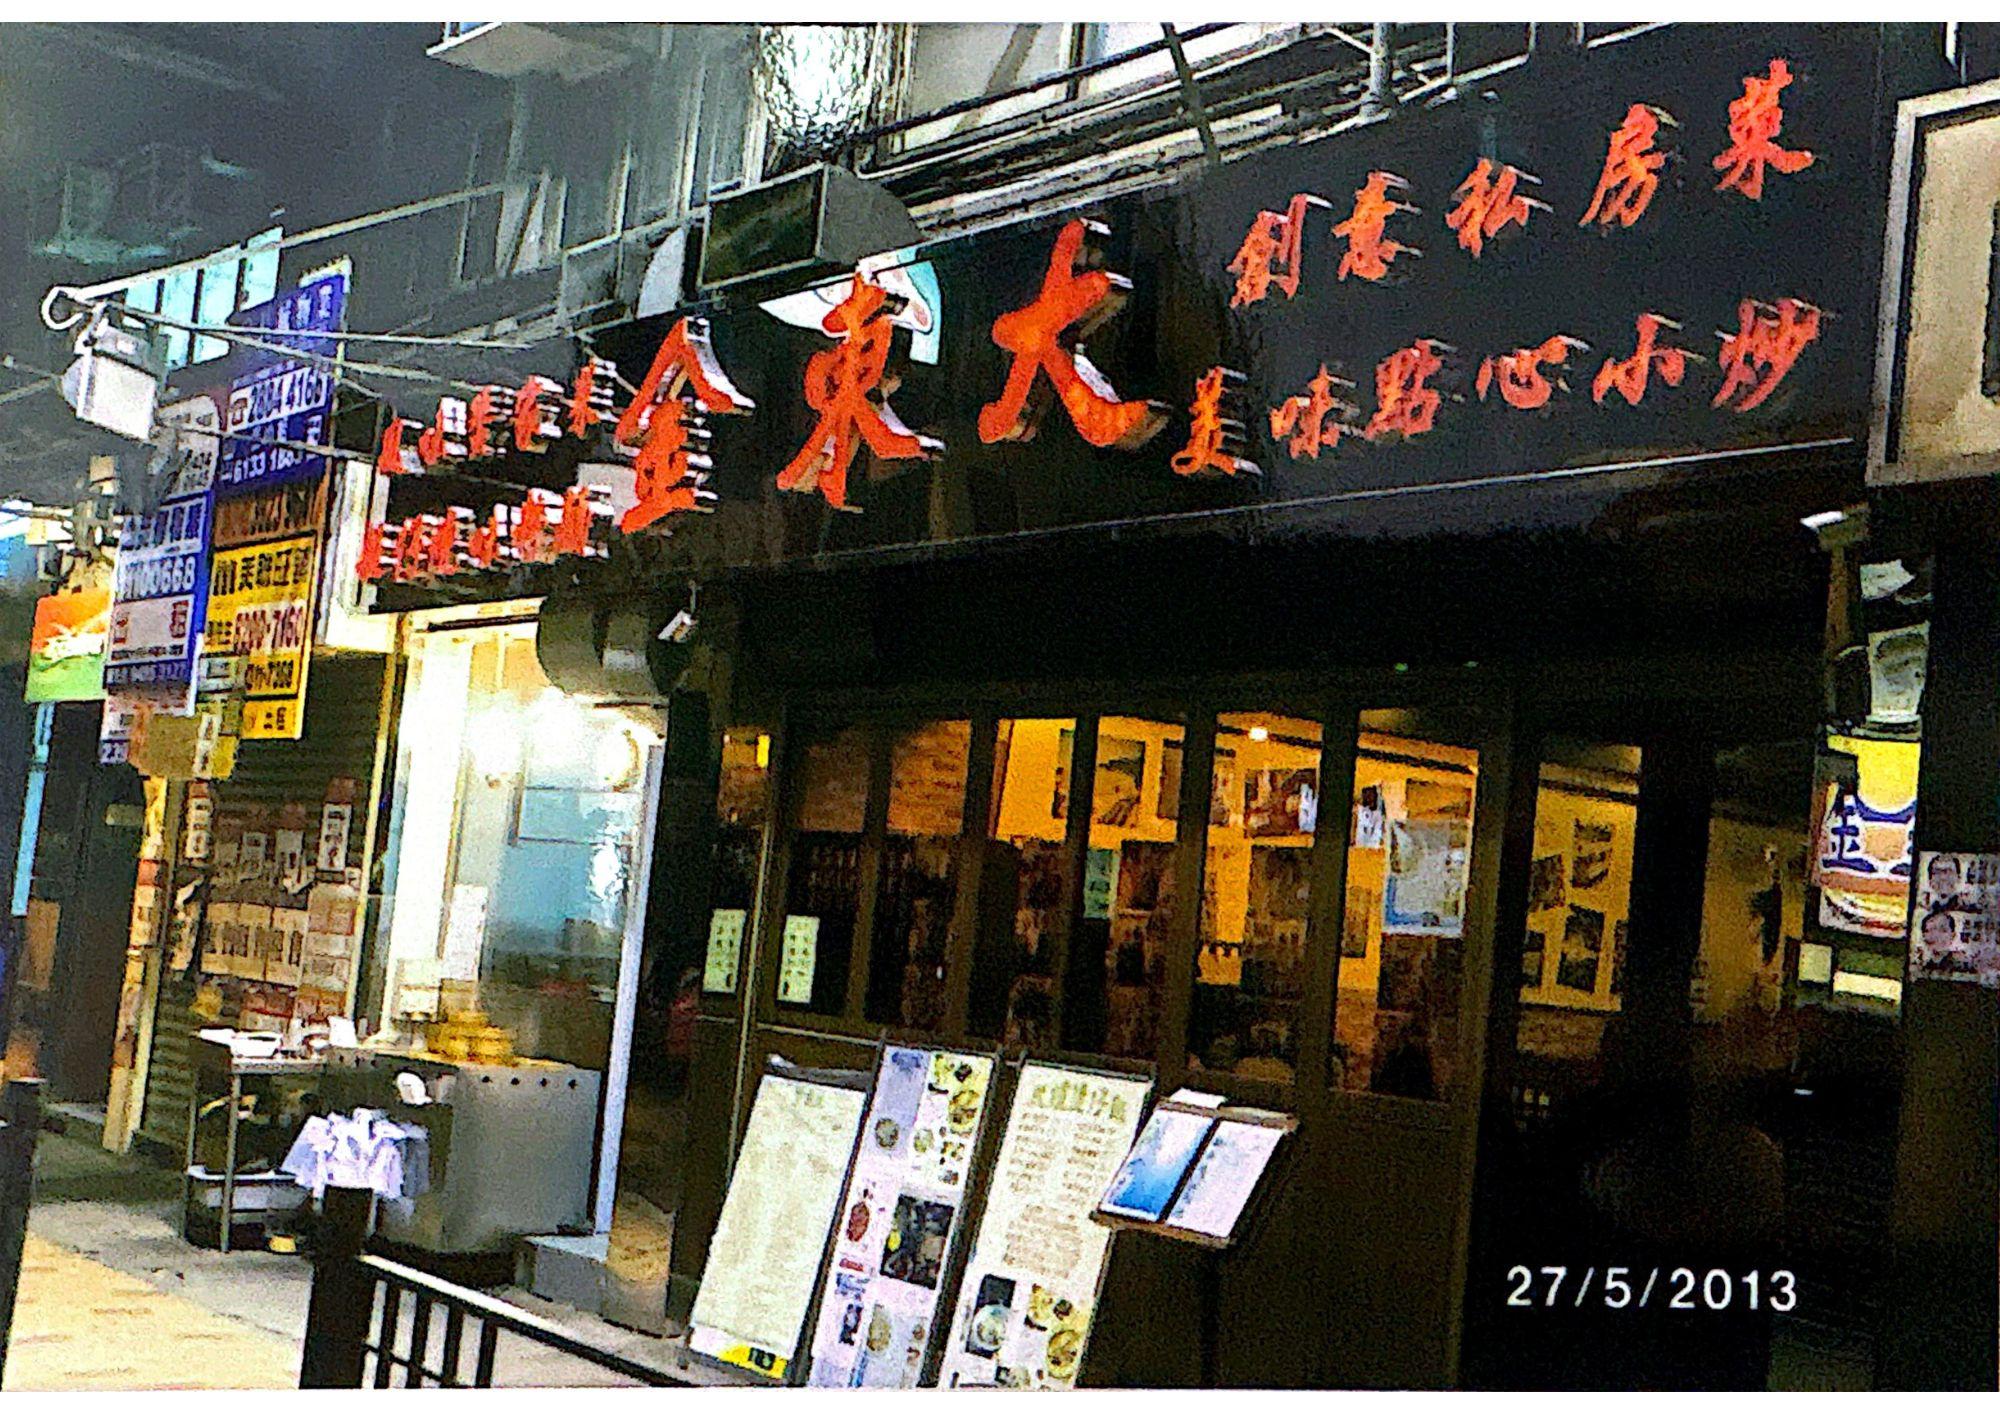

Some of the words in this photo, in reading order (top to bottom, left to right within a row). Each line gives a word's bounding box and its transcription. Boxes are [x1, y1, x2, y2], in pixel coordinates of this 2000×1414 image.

[1232, 60, 1812, 303] 創意私房菜
